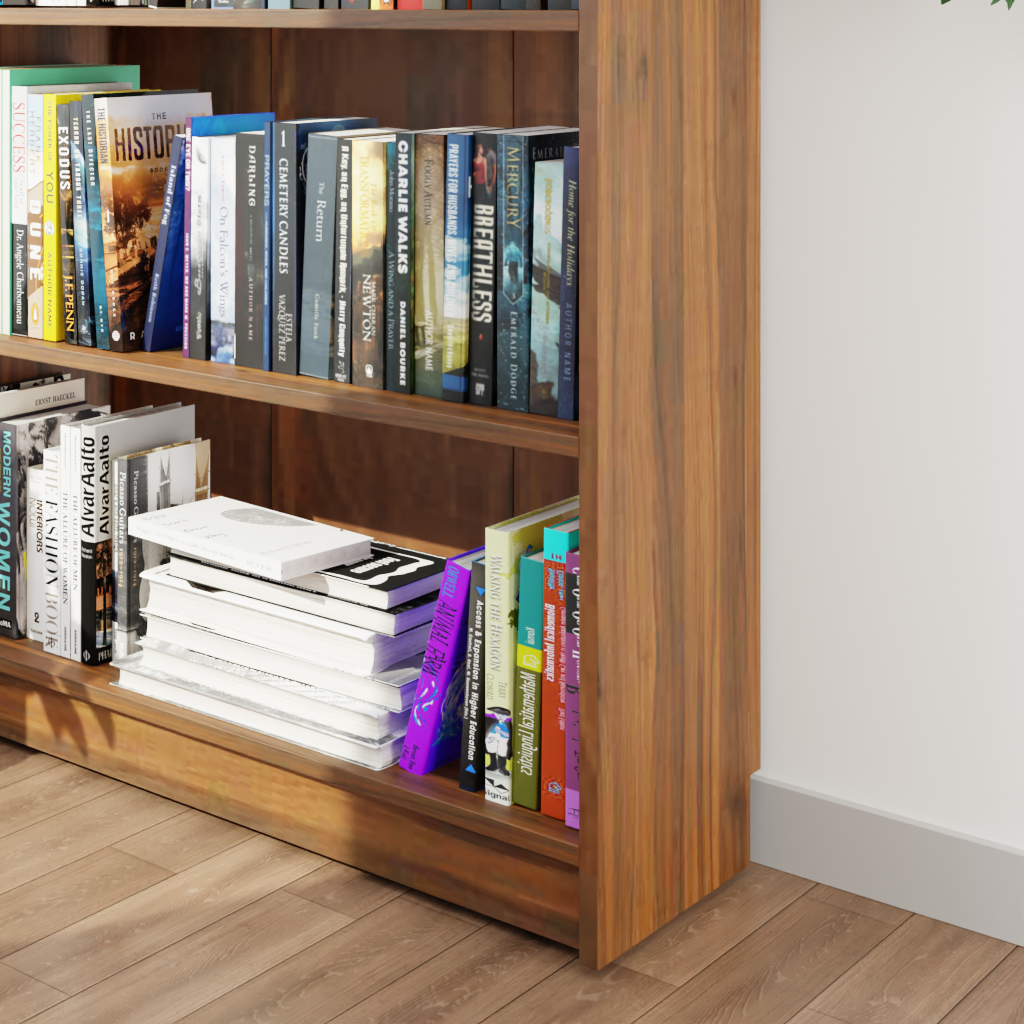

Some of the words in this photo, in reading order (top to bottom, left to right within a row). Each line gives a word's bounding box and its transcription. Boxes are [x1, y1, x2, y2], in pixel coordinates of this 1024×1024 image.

[98, 108, 106, 122] THE
[151, 112, 167, 120] THE
[12, 103, 25, 172] SUCCESS
[98, 123, 108, 164] HISTORIAN
[58, 126, 70, 190] EXODUS
[185, 159, 190, 170] OR
[248, 146, 256, 206] DARLING
[398, 140, 408, 212] CHARLIE
[424, 159, 434, 190] FOGGY
[164, 165, 177, 194] Island
[278, 158, 288, 219] CEMETERY
[506, 146, 522, 229] MERCURY
[567, 180, 577, 209] Home
[161, 208, 171, 225] Fog
[165, 196, 172, 206] of
[219, 207, 228, 227] On
[424, 191, 434, 226] AUTUMN
[566, 211, 576, 227] for
[16, 229, 24, 240] Dr.
[315, 200, 326, 242] Return
[567, 228, 575, 242] the
[15, 243, 24, 269] Angele
[29, 200, 42, 280] DUNE
[278, 221, 288, 274] CANDLES
[397, 214, 408, 274] WALKS
[151, 273, 160, 291] Keith
[472, 204, 494, 323] BREATHLESS
[565, 244, 575, 286] Holidays
[16, 272, 24, 324] Charbonneau
[148, 293, 157, 322] Robinson
[217, 281, 228, 317] Wings
[277, 294, 285, 334] VAZQUEZ
[362, 274, 372, 342] NEWTON
[424, 310, 433, 344] AUTHOR
[510, 311, 518, 358] EMERALD
[564, 303, 573, 346] AUTHOR
[278, 336, 286, 362] PEREZ
[424, 346, 433, 371] NAME
[564, 353, 572, 382] NAME
[35, 396, 51, 406] ERNST
[52, 392, 76, 403] HAECKEL
[510, 364, 518, 400] DODGE
[3, 431, 11, 498] MODERN
[45, 456, 58, 496] THE
[82, 437, 94, 484] Aalto
[100, 436, 109, 483] Aalto
[118, 472, 126, 506] Picasso
[82, 487, 94, 538] Alvar
[100, 486, 109, 534] Alvar
[118, 508, 126, 544] Guitars
[45, 500, 58, 591] FASHION
[442, 566, 459, 599] ORWELL
[490, 555, 502, 600] WALKING
[45, 592, 58, 650] BOOK
[430, 599, 457, 647] ANIMAL
[475, 600, 484, 629] Access
[490, 602, 502, 621] THE
[423, 645, 447, 678] FARM
[472, 639, 482, 680] Expansion
[490, 623, 504, 672] HEXAGON
[472, 682, 479, 690] in
[469, 692, 479, 719] Higher
[468, 721, 477, 760] Education
